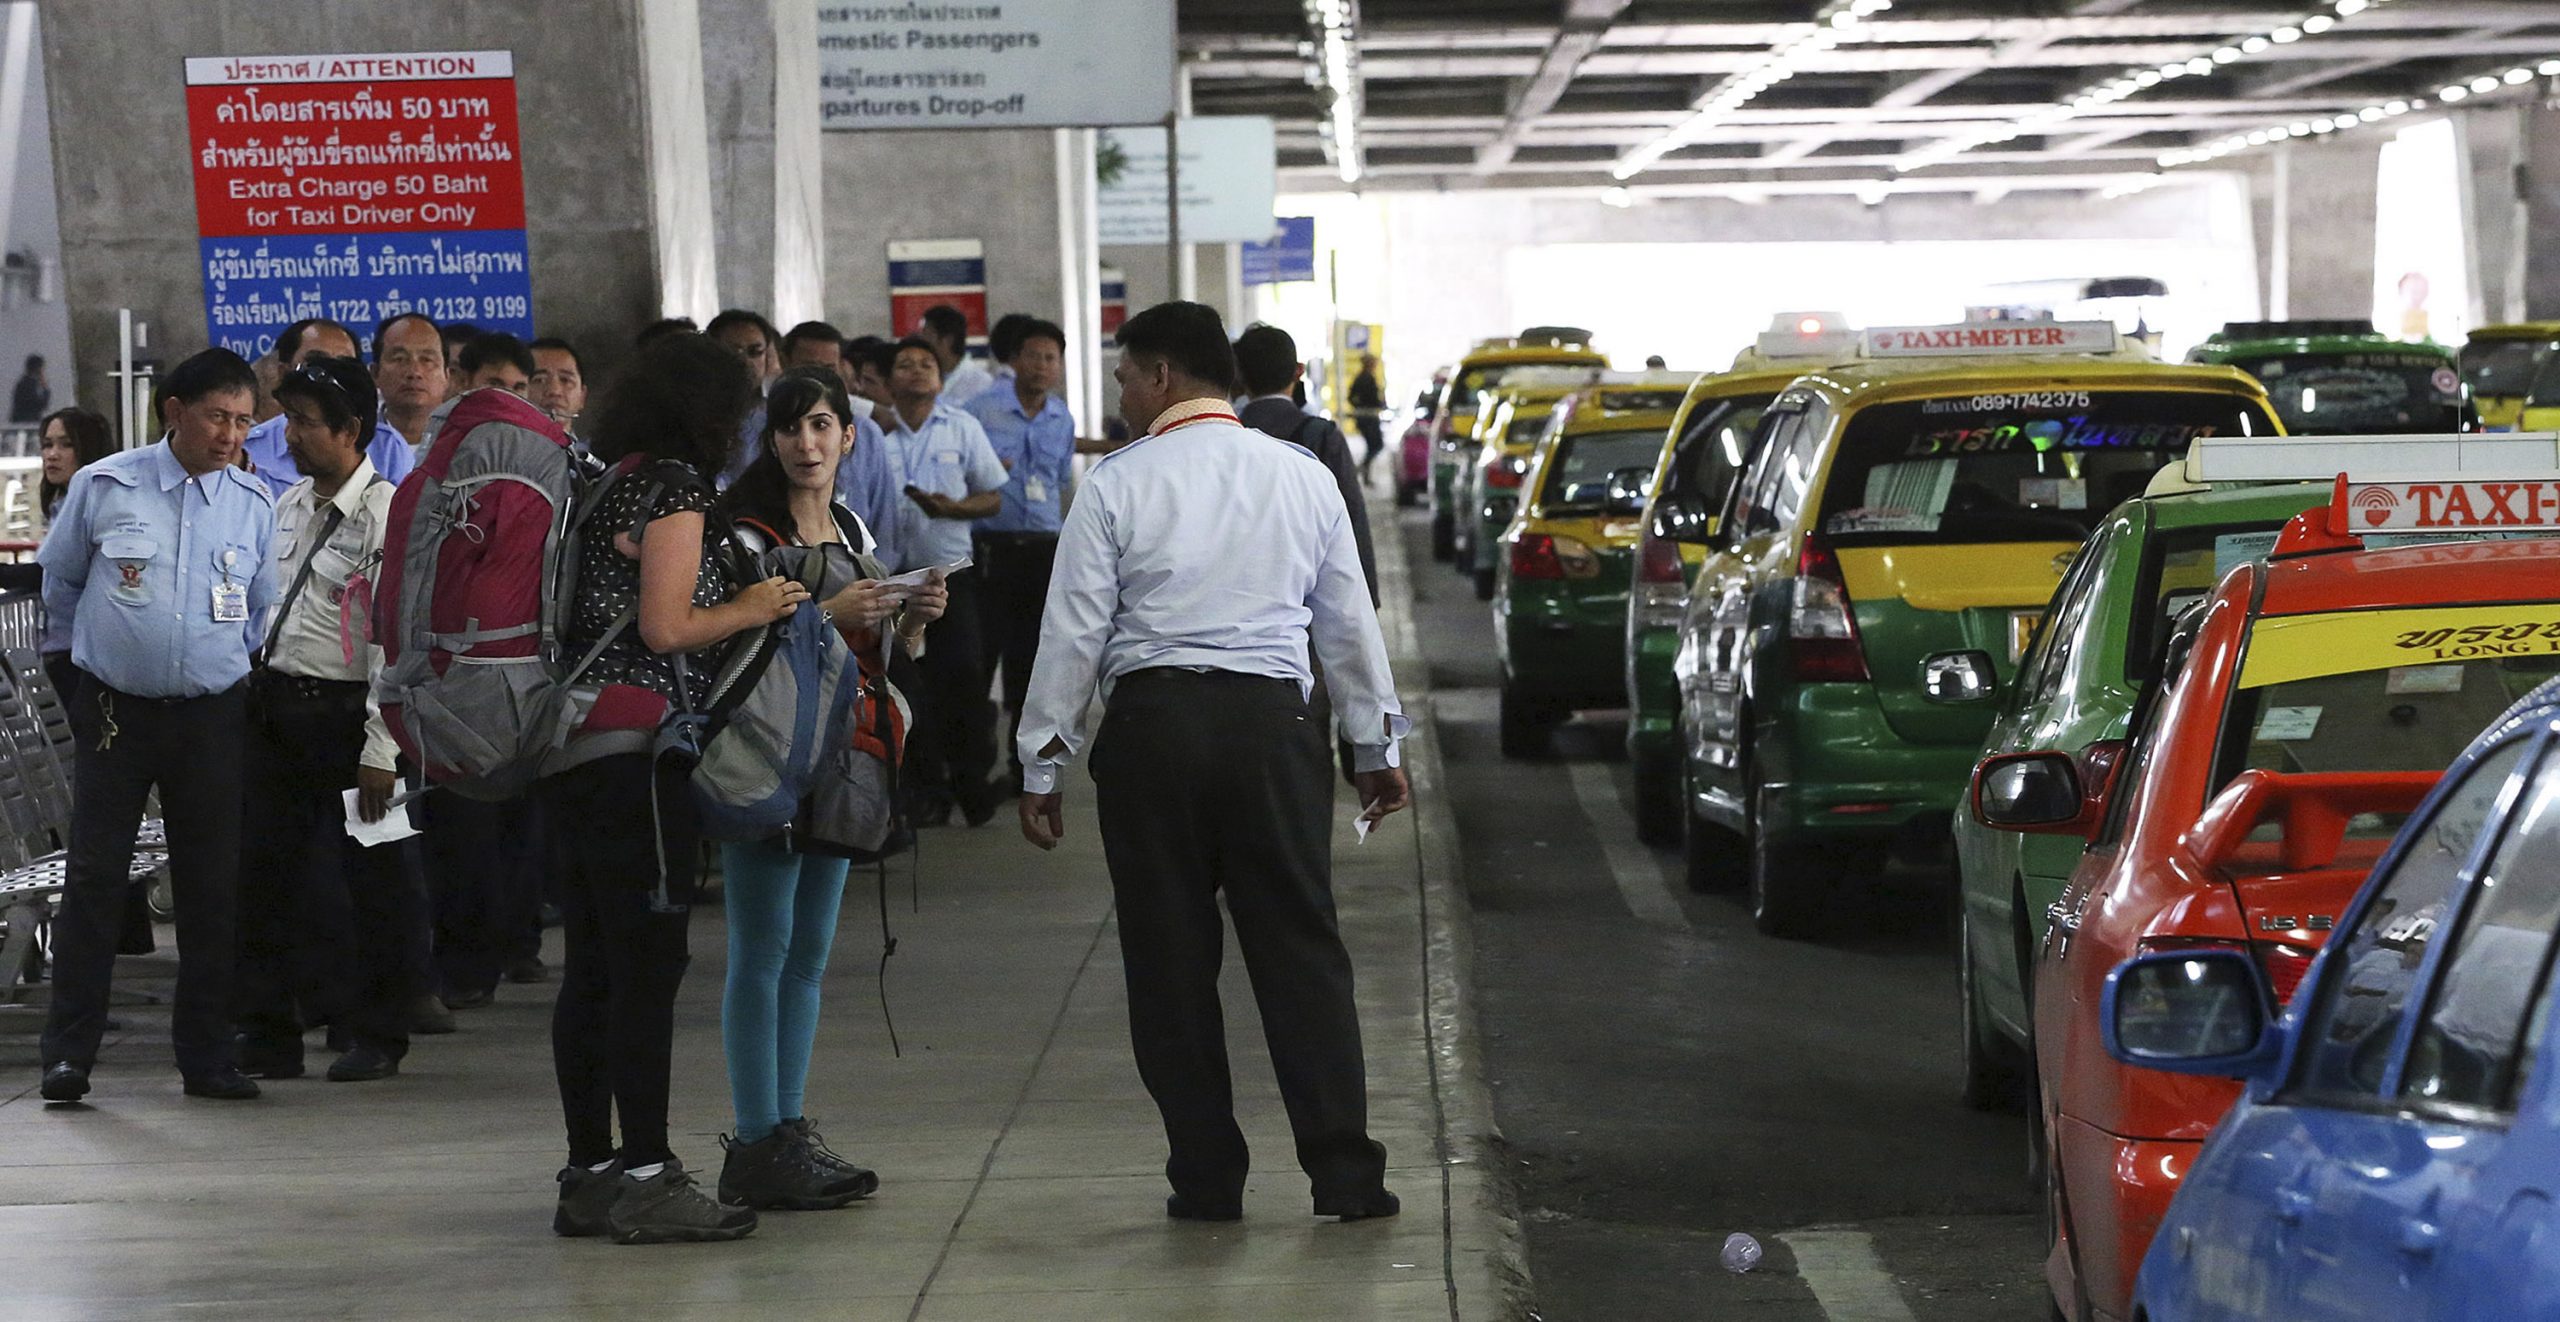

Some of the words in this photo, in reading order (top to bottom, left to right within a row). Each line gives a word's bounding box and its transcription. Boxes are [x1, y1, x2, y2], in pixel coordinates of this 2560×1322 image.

[906, 30, 1040, 53] Passengers
[224, 59, 310, 80] ประกาศ
[329, 58, 475, 77] ATTENTION
[216, 87, 392, 124] ค่าโดยสารเพิ่ม
[402, 97, 432, 120] 50
[439, 97, 489, 118] บาท
[821, 99, 921, 119] partures
[929, 95, 1025, 118] Drop-off
[229, 179, 292, 199] Extra
[299, 177, 387, 200] Charge
[395, 175, 425, 194] 50
[432, 173, 488, 193] Baht
[247, 207, 278, 227] for
[286, 206, 335, 226] Taxi
[343, 204, 414, 224] Driver
[420, 202, 476, 226] Only
[369, 239, 522, 285] บริการไม่สุภาพ
[329, 299, 371, 322] 1722
[433, 297, 477, 320] 2132
[483, 295, 527, 319] 9199
[1898, 327, 2065, 349] TAXI-METER
[2406, 482, 2560, 527] TAXI-
[2433, 642, 2530, 659] LONG
